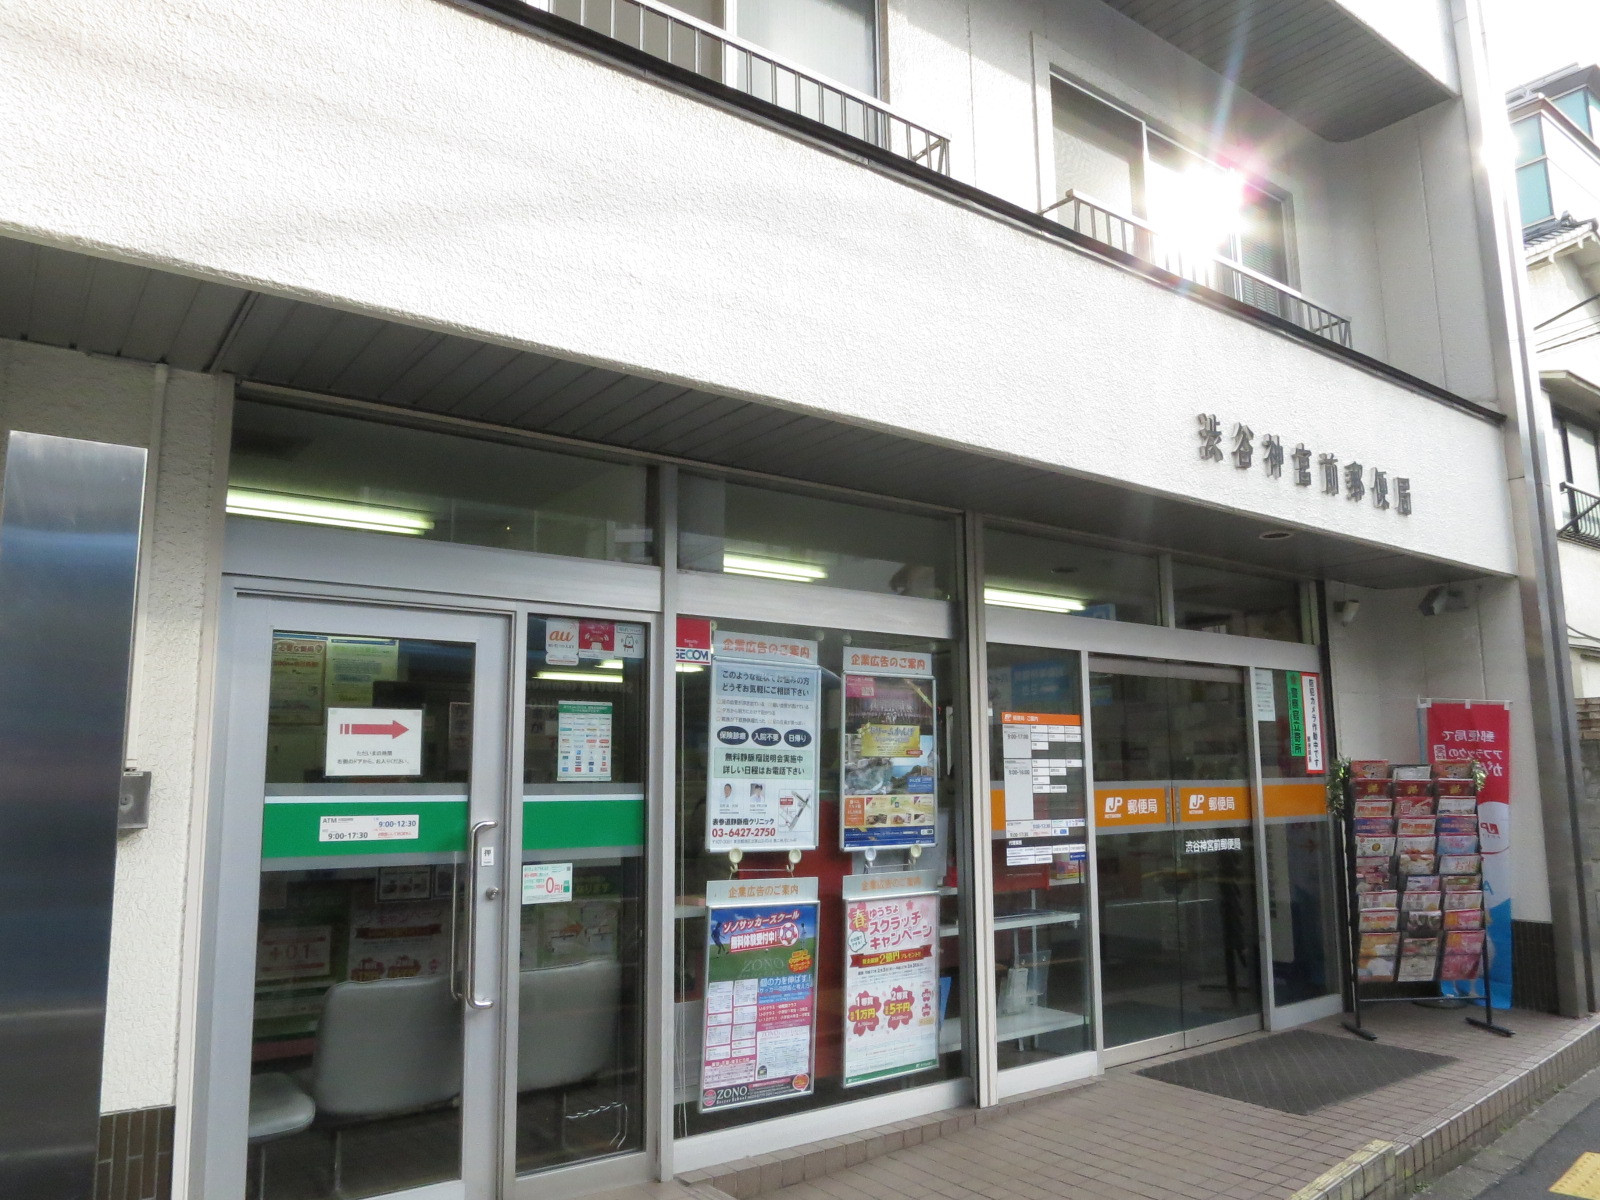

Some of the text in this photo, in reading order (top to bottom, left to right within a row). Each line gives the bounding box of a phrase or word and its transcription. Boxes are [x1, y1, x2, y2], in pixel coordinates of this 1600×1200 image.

[1197, 413, 1412, 516] 渋谷神宮前郵便局
[549, 630, 574, 642] au
[723, 638, 810, 659] 企業広告のご案内
[851, 654, 926, 670] 企業広告のご案内
[721, 682, 810, 697] どうぞお気軽にご相談下さい
[1308, 679, 1320, 768] 防犯カメラ作動中です
[754, 733, 780, 742] 入院不要
[788, 734, 807, 743] 日帰り
[725, 753, 804, 764] 無料静脈瘤説明会実施中
[723, 765, 805, 776] 詳しい日程はお電話下さい
[1127, 799, 1158, 815] 郵便局
[1208, 797, 1235, 811] 郵便局
[378, 820, 417, 828] 9:00-12:30
[328, 832, 369, 840] 9:00-17:30
[712, 828, 776, 838] 03-6427-2750
[1185, 838, 1242, 853] 渋谷神宮前郵便局
[484, 849, 492, 857] 押
[728, 884, 799, 899] 企業広告のご案内
[853, 908, 867, 928] 春
[869, 904, 900, 918] ゆうちょ
[869, 911, 922, 936] スクラッチ
[870, 925, 933, 950] キャンペーン
[717, 1085, 748, 1099] ZONO
